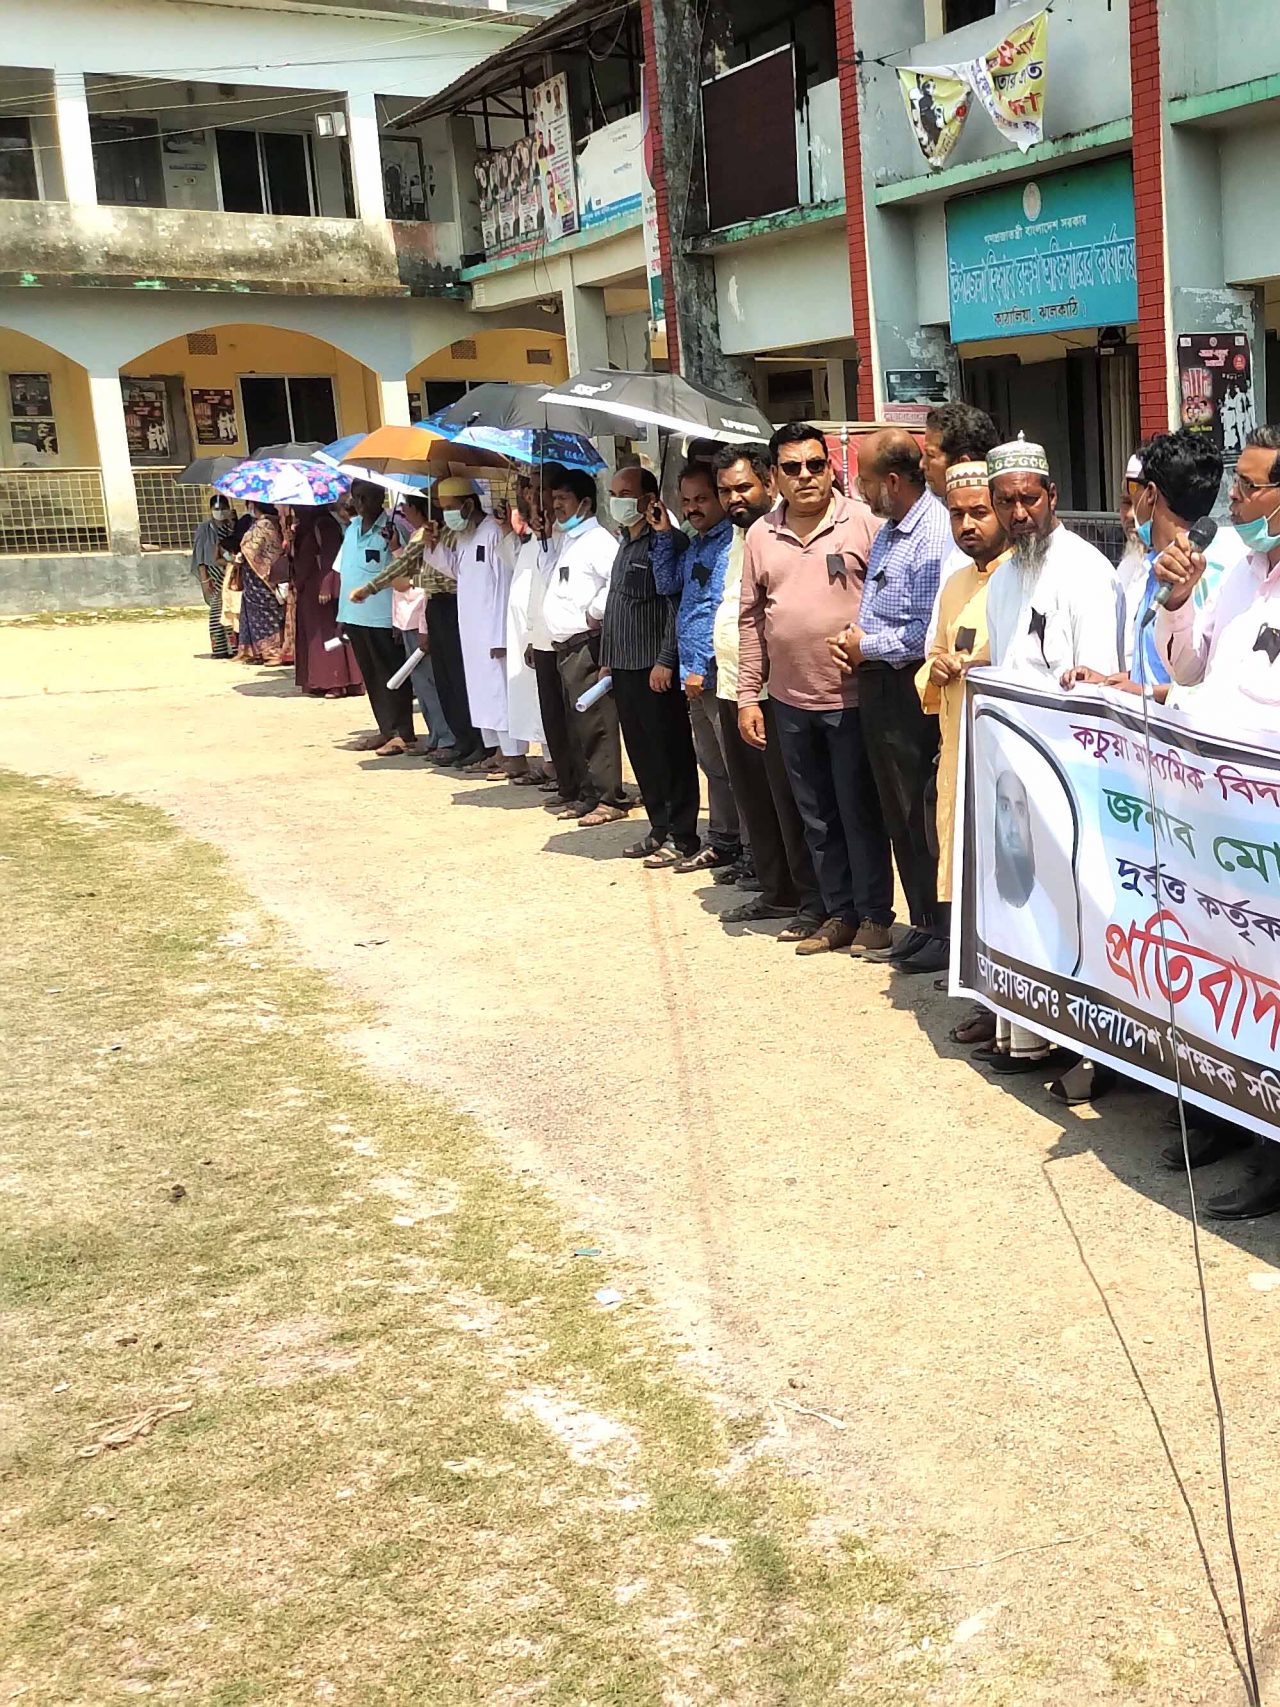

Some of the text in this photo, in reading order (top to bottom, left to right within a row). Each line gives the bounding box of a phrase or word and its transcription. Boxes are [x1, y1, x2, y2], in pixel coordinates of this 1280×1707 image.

[1024, 220, 1059, 237] বাংলাদেশ
[1060, 214, 1087, 229] সরকার
[950, 257, 988, 304] উপজেলা
[1069, 725, 1129, 763] কচুয়া
[1065, 992, 1167, 1063] বাংলাদেশ
